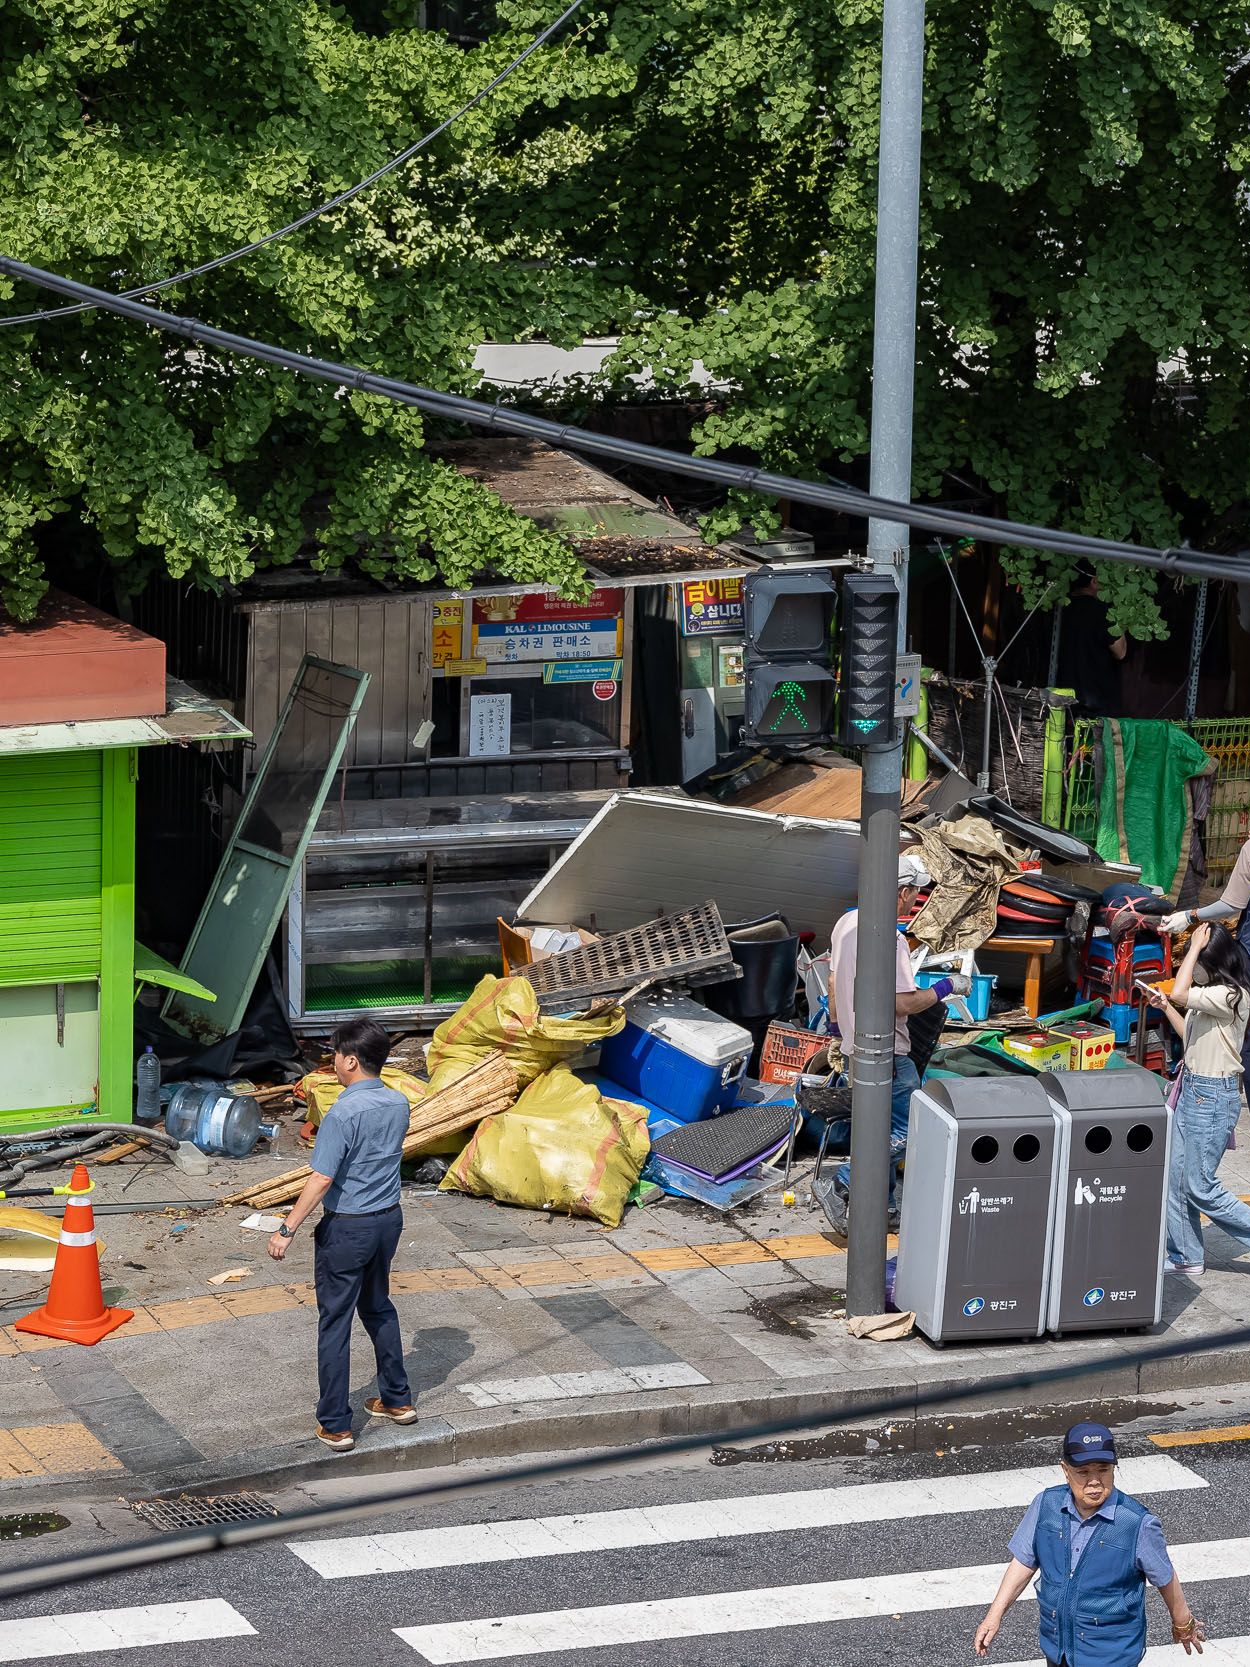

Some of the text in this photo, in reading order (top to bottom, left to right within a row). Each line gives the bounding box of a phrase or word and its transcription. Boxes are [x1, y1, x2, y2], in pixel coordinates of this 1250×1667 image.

[707, 604, 741, 619] 삽니다
[505, 622, 591, 634] KAL LIMOUSINE
[505, 636, 544, 650] 승차권
[552, 635, 591, 648] 판매소
[572, 650, 591, 658] 18:50
[1099, 1186, 1127, 1195] 재활용품
[980, 1196, 1014, 1206] 일반쓰레기
[1099, 1195, 1123, 1203] Recycle
[1109, 1290, 1137, 1301] 광진구
[990, 1299, 1017, 1311] 광진구
